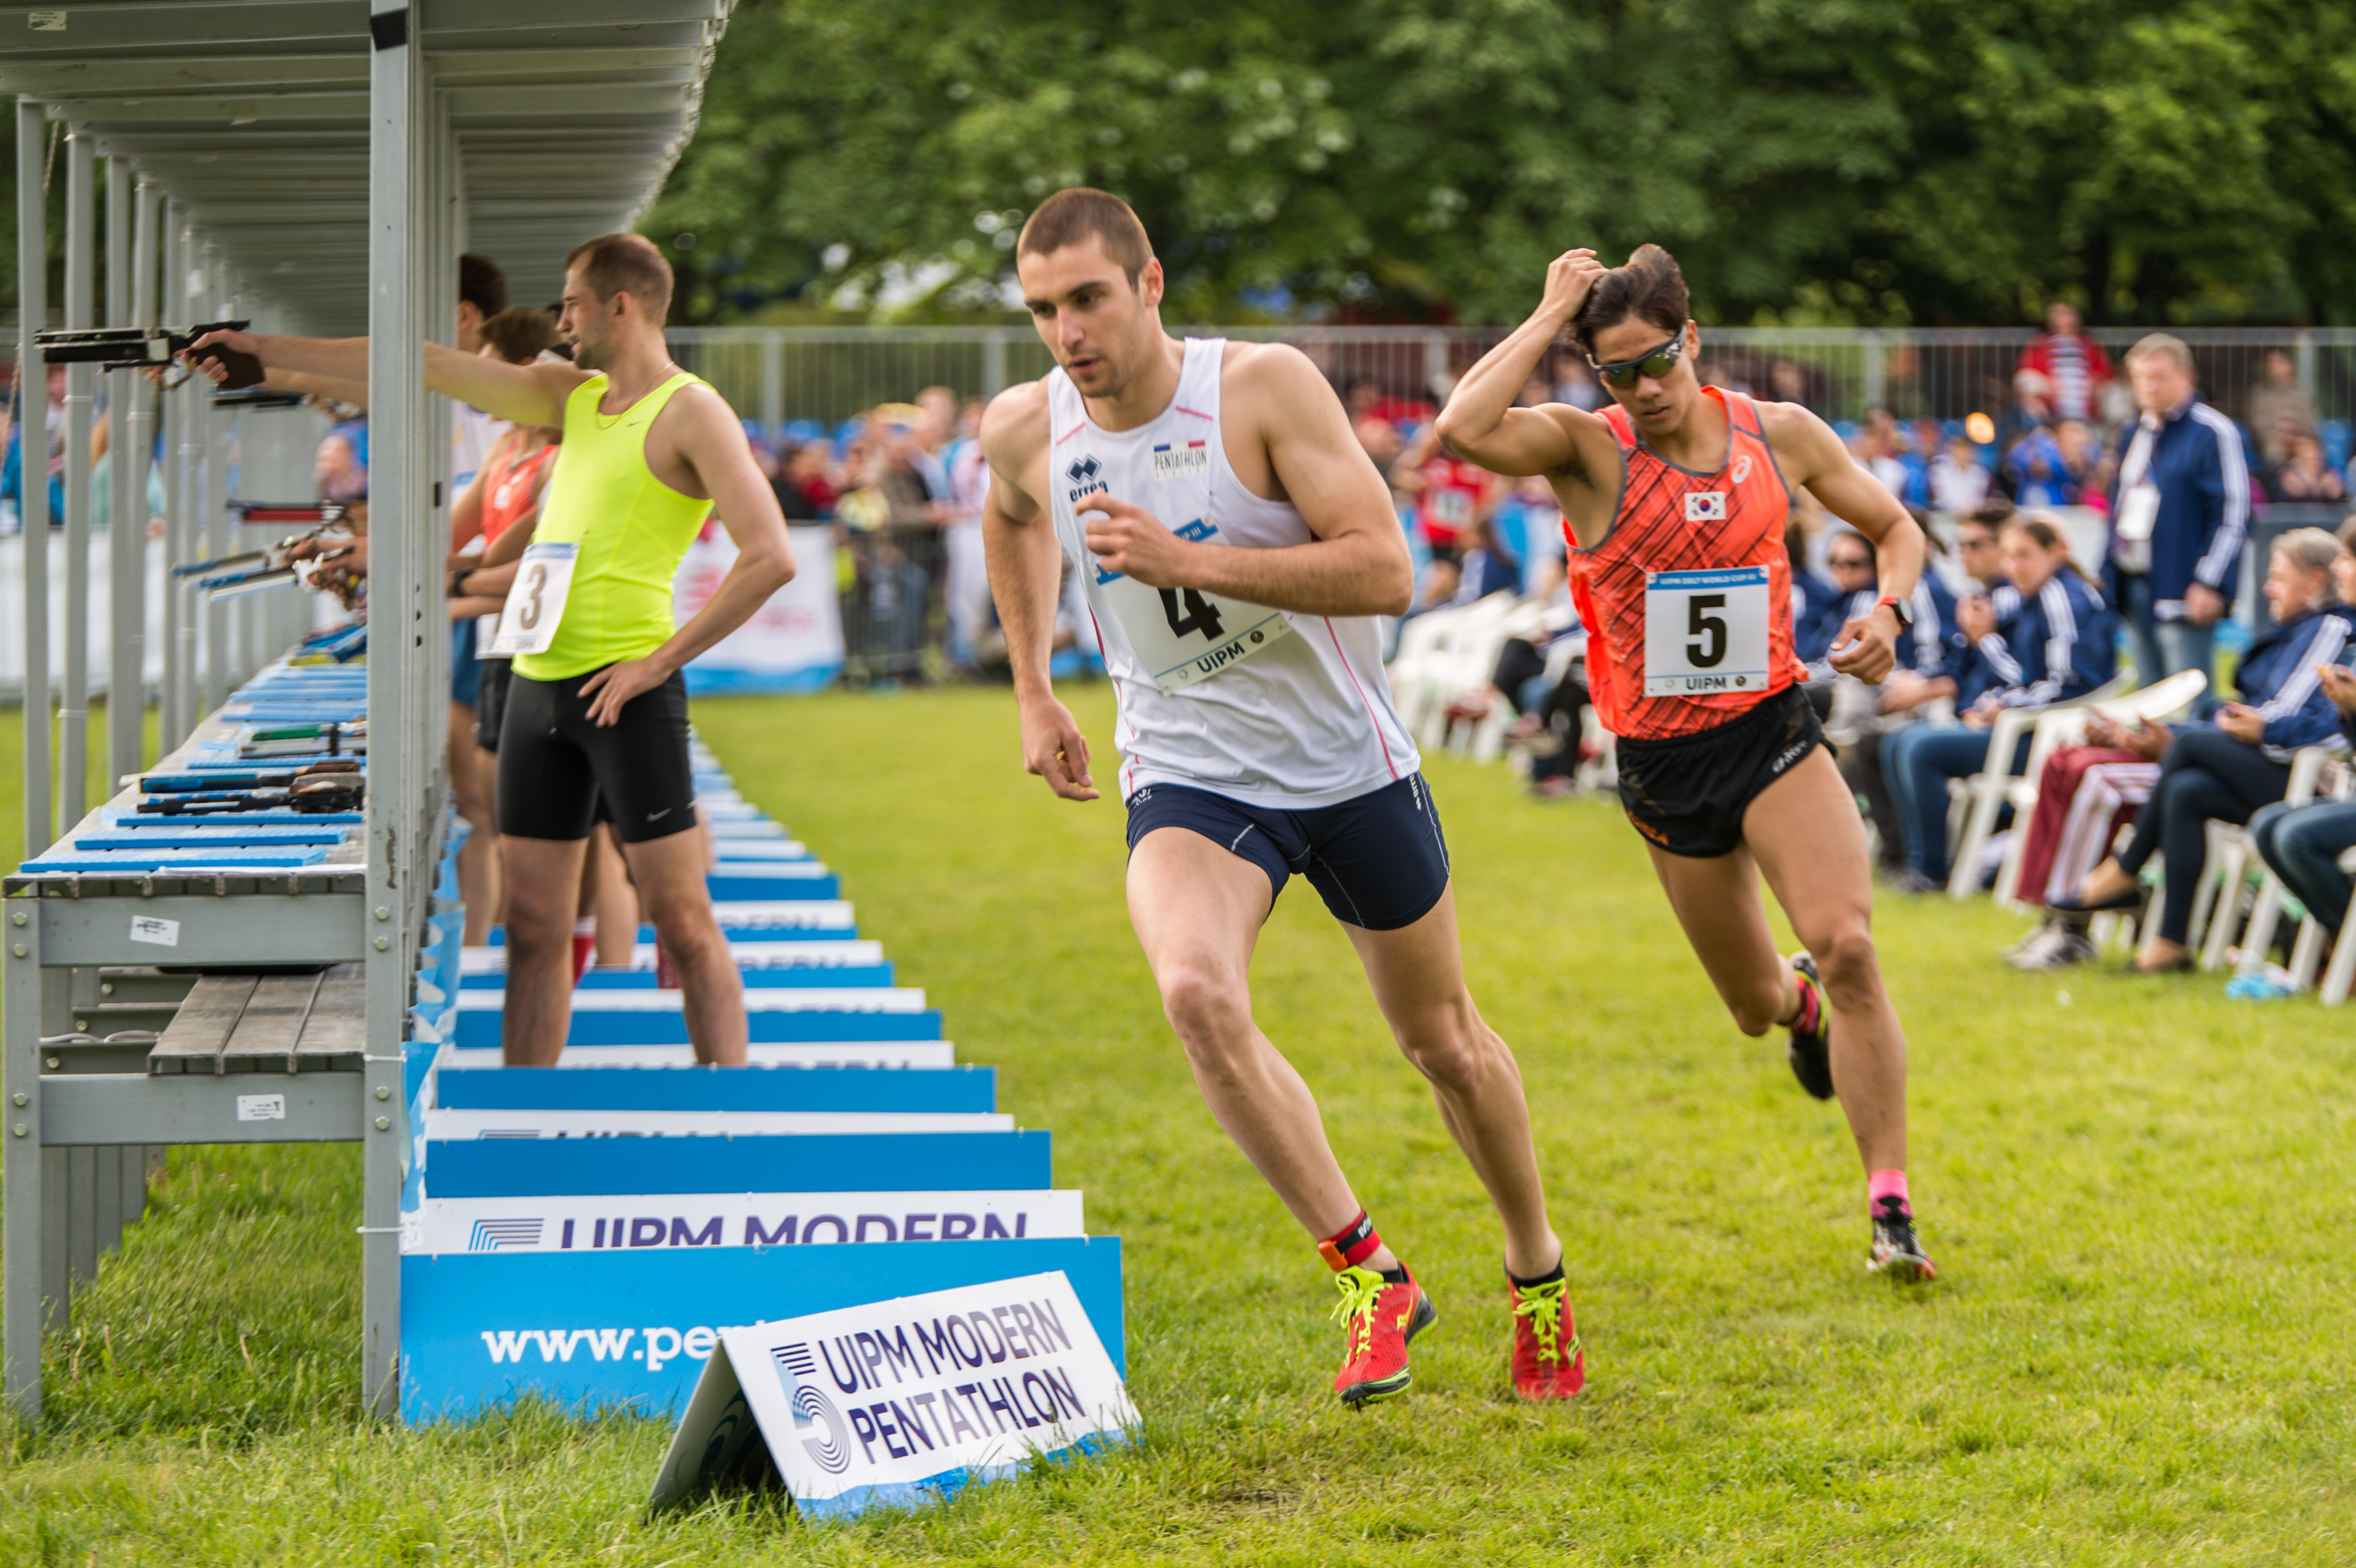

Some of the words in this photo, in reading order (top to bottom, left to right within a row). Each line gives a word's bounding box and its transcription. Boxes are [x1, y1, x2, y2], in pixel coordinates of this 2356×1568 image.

[1154, 450, 1207, 471] PENTATHLON
[520, 564, 548, 630] 3
[1157, 587, 1226, 641] 4
[1196, 641, 1246, 672] UIPM
[1686, 594, 1727, 668] 5
[1686, 677, 1726, 690] UIPM
[481, 1320, 766, 1371] www.pe
[819, 1324, 924, 1394] UIPM
[913, 1298, 1073, 1375] MODERN
[847, 1366, 1086, 1464] PENTATHLON
